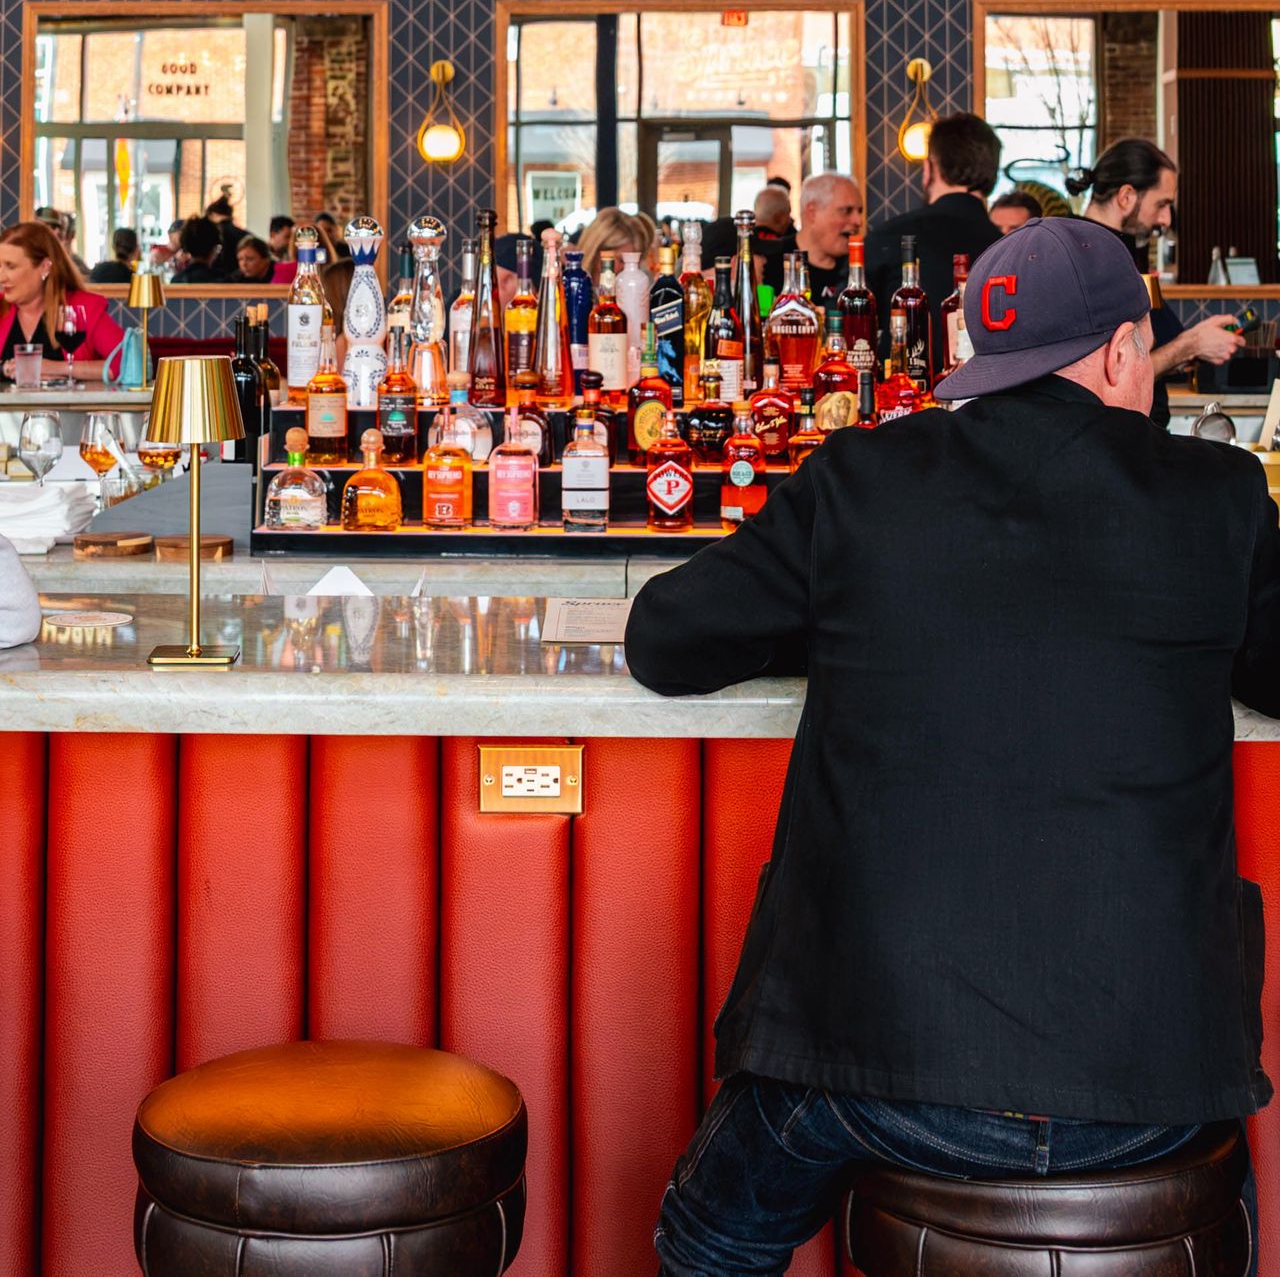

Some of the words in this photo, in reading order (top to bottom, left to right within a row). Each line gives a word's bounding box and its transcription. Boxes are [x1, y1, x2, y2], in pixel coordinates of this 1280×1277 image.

[162, 63, 197, 74] GOOD
[148, 84, 210, 96] COMPANY
[982, 275, 1017, 332] C
[665, 479, 680, 495] P
